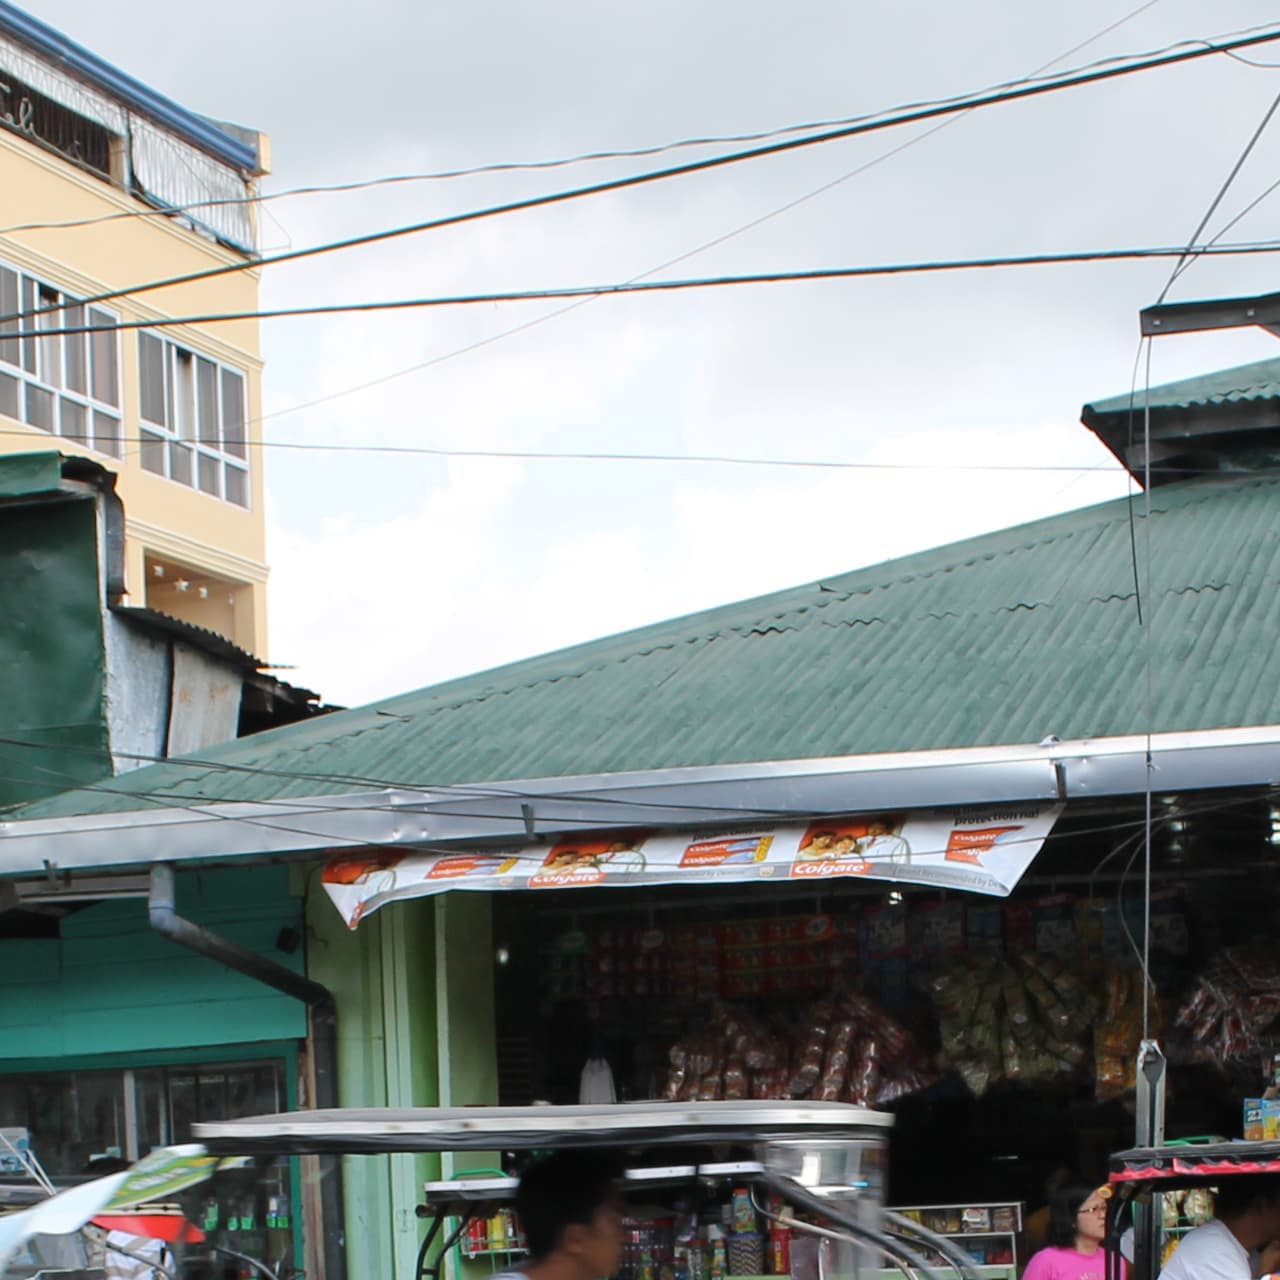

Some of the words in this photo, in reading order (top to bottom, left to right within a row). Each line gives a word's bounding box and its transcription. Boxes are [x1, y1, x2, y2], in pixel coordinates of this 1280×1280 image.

[953, 833, 997, 845] Colgate
[794, 862, 865, 876] Colgate
[532, 872, 600, 886] Colgate
